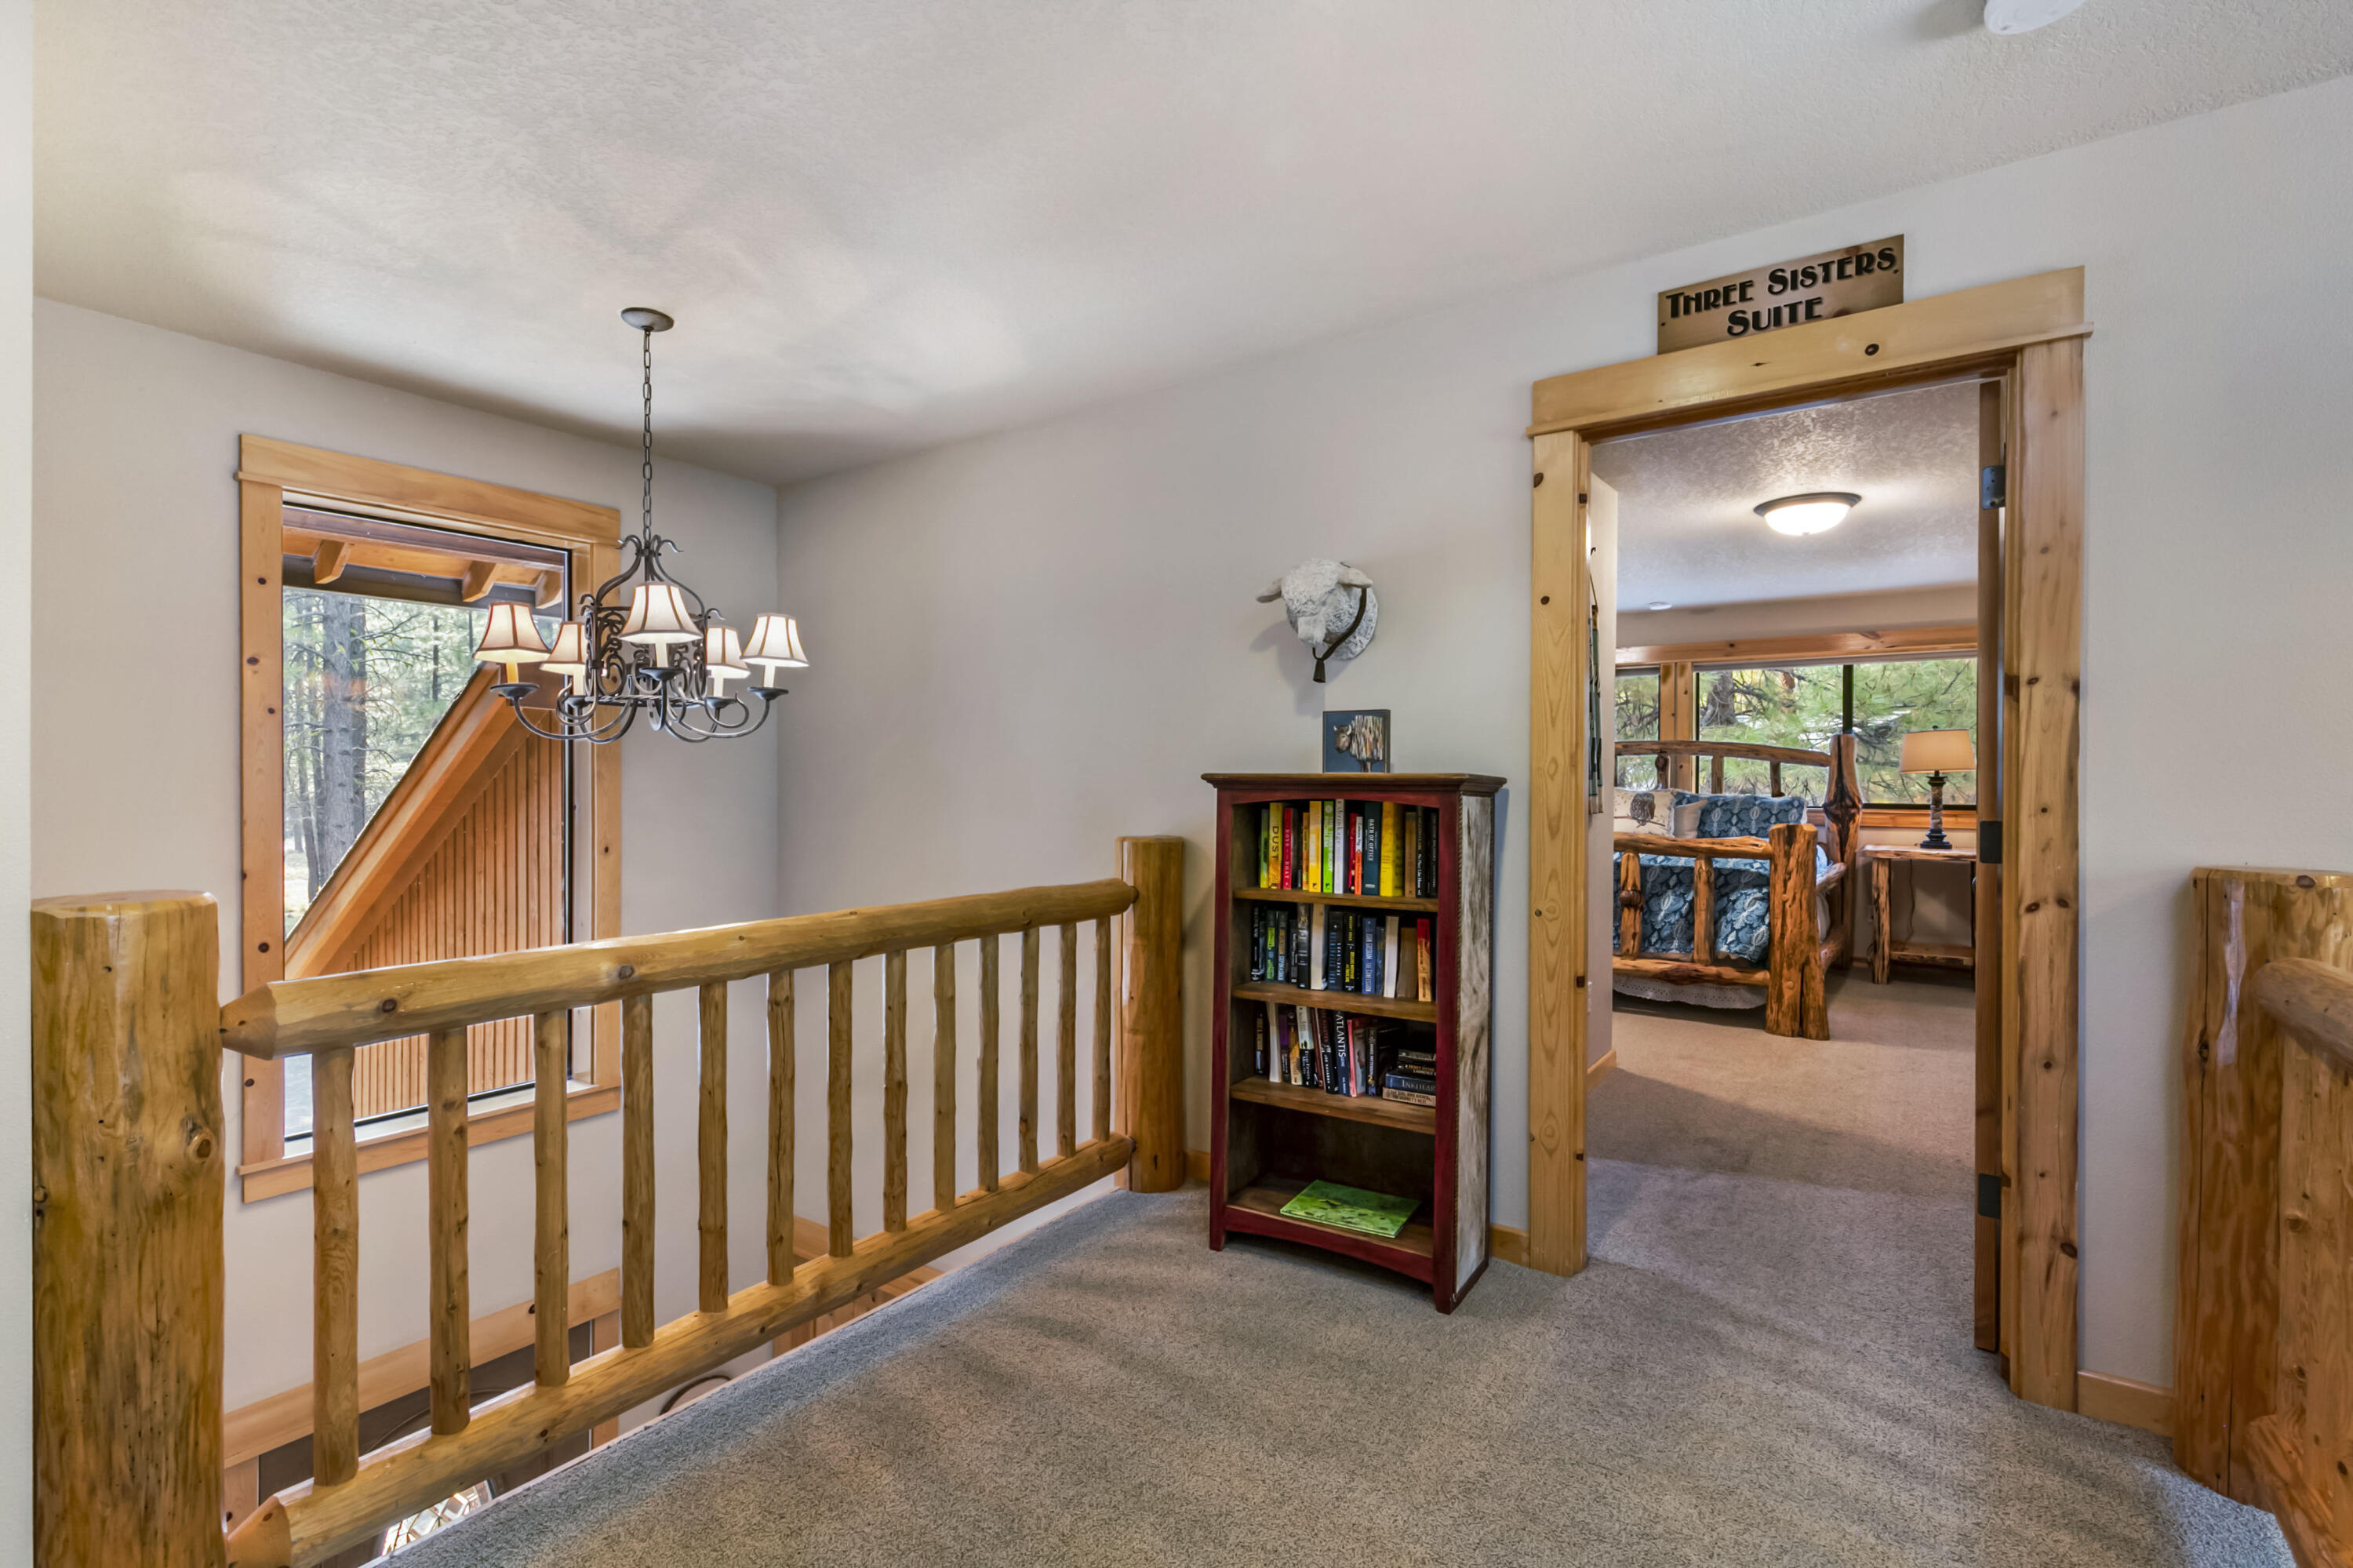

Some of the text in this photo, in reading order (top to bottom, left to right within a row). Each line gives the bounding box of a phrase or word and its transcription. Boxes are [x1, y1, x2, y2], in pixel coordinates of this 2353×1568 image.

[1665, 246, 1897, 318] THREE SISTERS
[1726, 297, 1823, 337] SUITE
[1336, 1014, 1346, 1057] ATLANTIS
